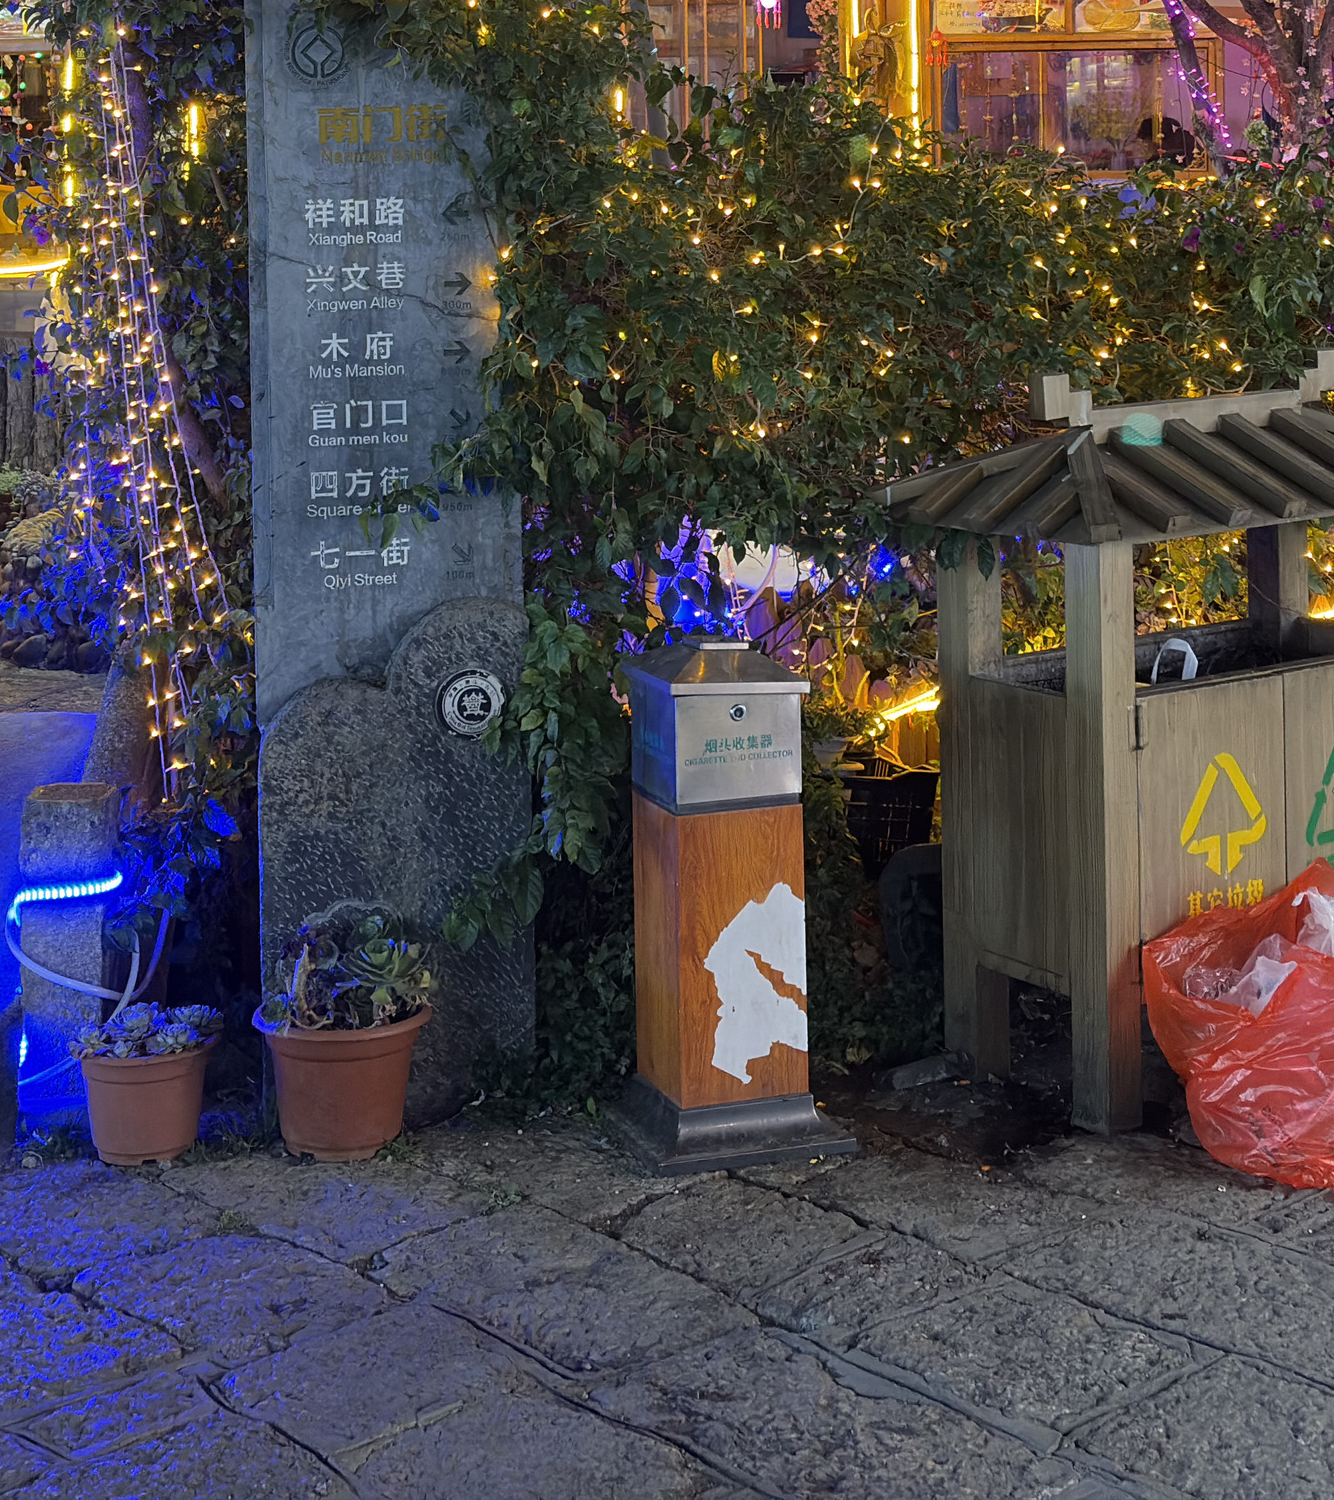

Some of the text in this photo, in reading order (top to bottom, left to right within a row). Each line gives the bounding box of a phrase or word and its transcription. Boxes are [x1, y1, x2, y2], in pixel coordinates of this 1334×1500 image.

[317, 104, 447, 145] 南门街
[304, 197, 405, 229] 祥和路
[308, 230, 402, 247] Xianghe Road
[305, 261, 406, 294] 兴文巷
[307, 296, 405, 313] Xingwen Alley
[320, 331, 394, 362] 木府
[309, 362, 405, 379] Mu's Mansion
[309, 399, 408, 431] 官门口
[308, 431, 408, 448] Guan men kou
[309, 466, 410, 500] 四方街
[307, 504, 363, 520] Square
[310, 537, 411, 570] 七一街
[323, 572, 398, 589] Qiyi Street
[703, 733, 773, 754] 烟头收集器
[748, 749, 794, 762] COLLECTOR
